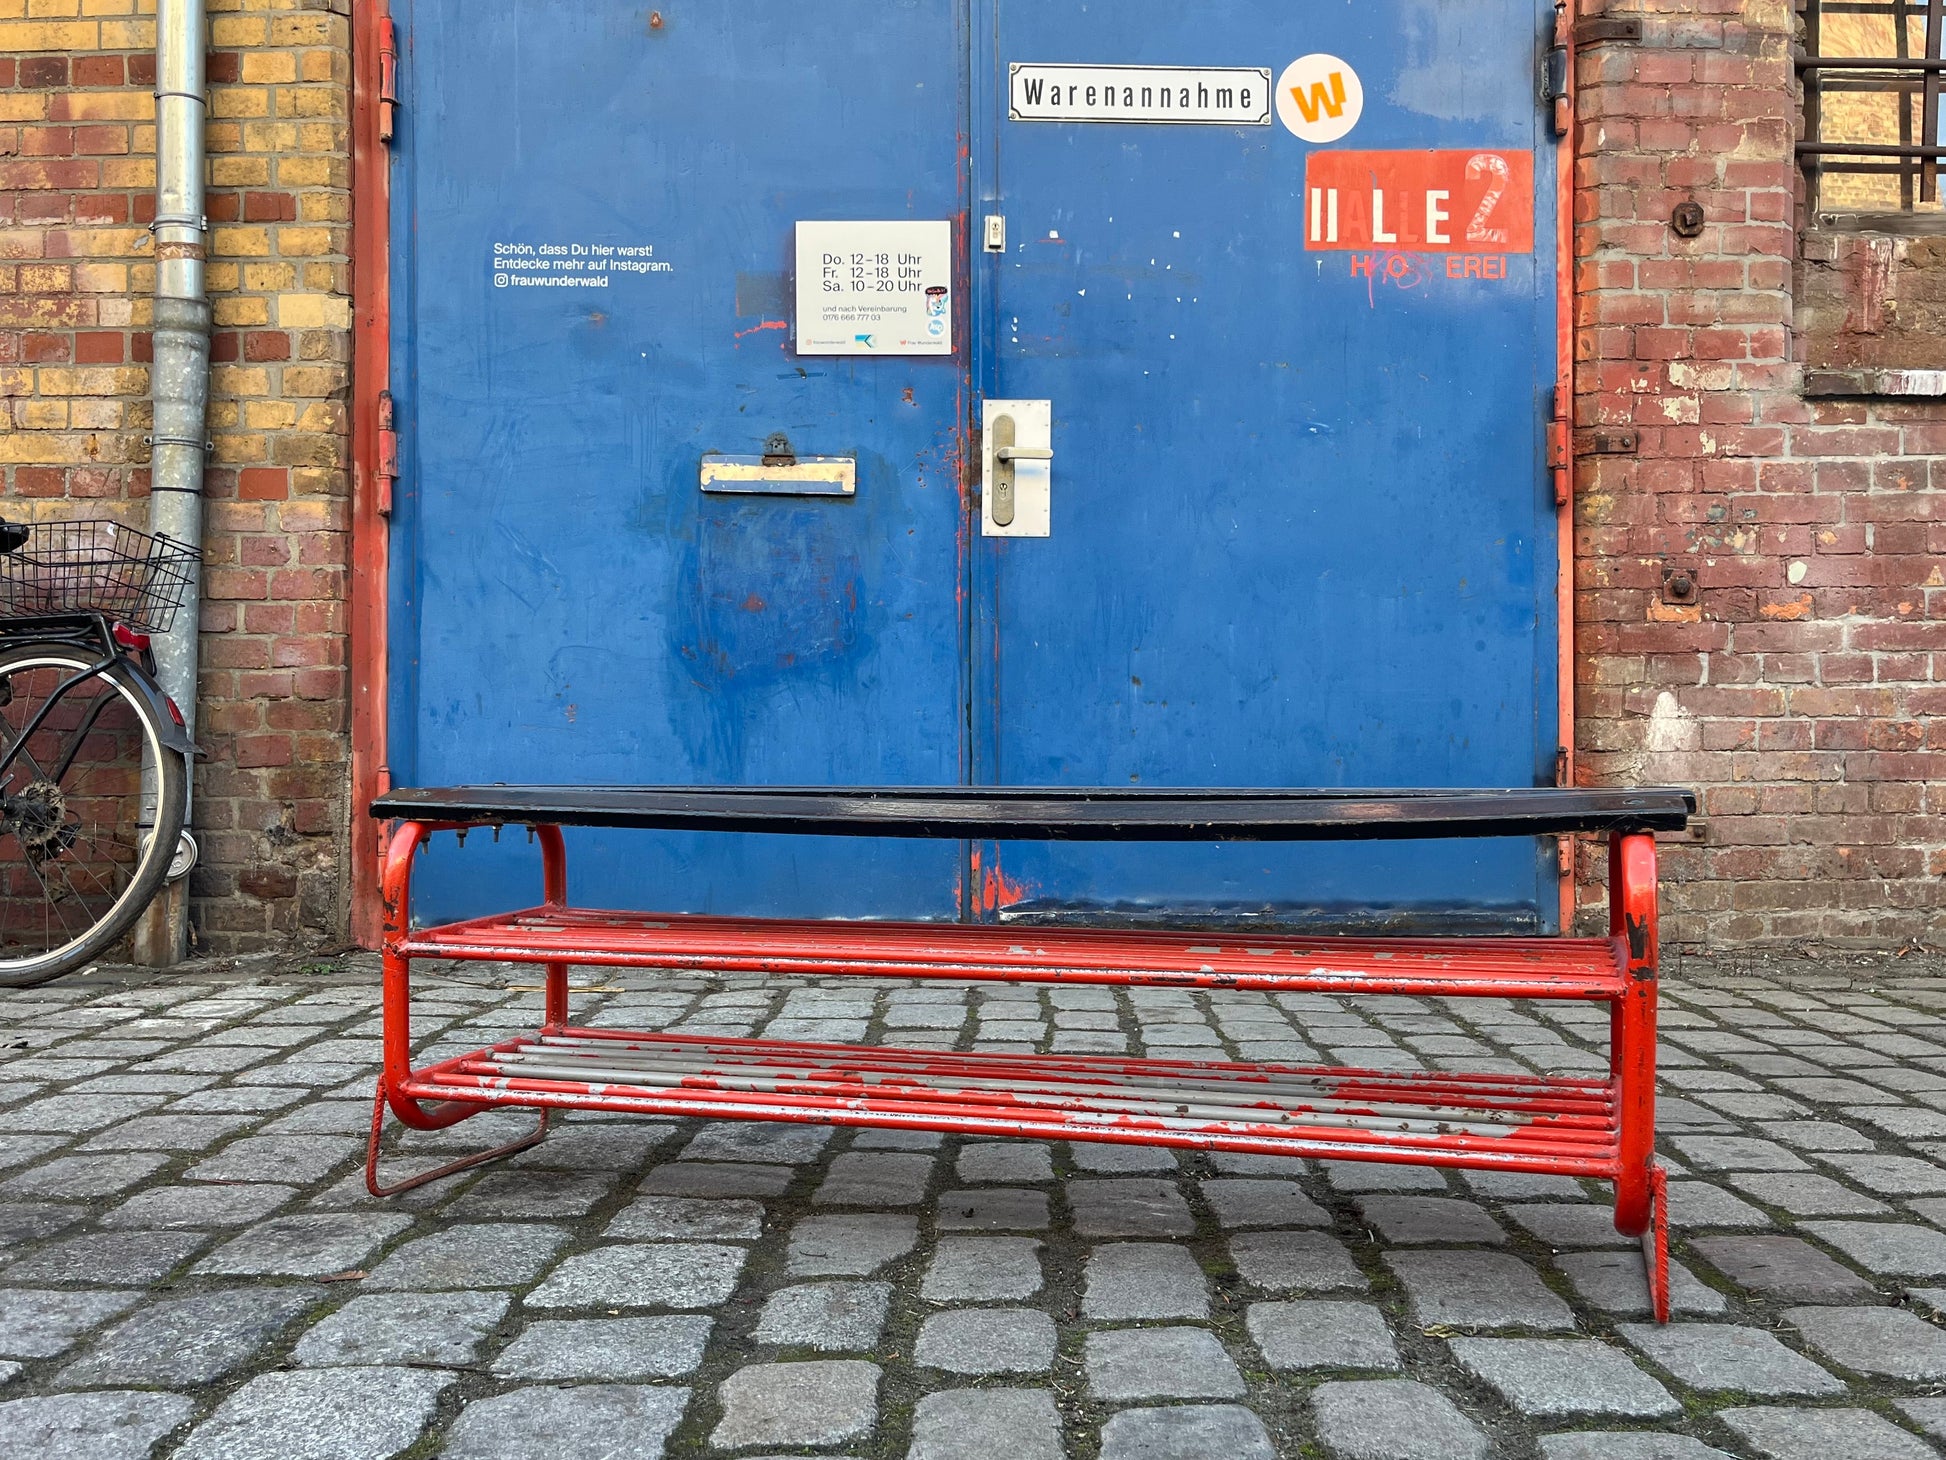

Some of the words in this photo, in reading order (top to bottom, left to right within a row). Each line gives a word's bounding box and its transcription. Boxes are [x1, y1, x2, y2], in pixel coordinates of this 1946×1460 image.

[1023, 77, 1252, 109] Warenannahme
[1464, 153, 1510, 244] 2
[494, 243, 536, 256] Schön,
[539, 244, 568, 255] dass
[571, 244, 589, 255] Du
[591, 244, 615, 256] hier
[616, 245, 653, 257] warst!
[823, 253, 845, 265] Do.
[897, 253, 922, 265] Uhr
[494, 258, 550, 270] Entdecke
[553, 258, 585, 270] mehr
[587, 259, 607, 271] auf
[610, 259, 674, 273] Instagram.
[823, 267, 839, 278] Fr.
[897, 267, 922, 278] Uhr
[510, 274, 609, 287] frauwunderwald
[823, 280, 844, 292] Sa.
[897, 280, 922, 292] Uhr
[822, 305, 837, 313] und
[838, 305, 857, 313] nach
[858, 305, 907, 314] Vereinbarung
[822, 313, 839, 321] 0176
[857, 313, 870, 321] 777
